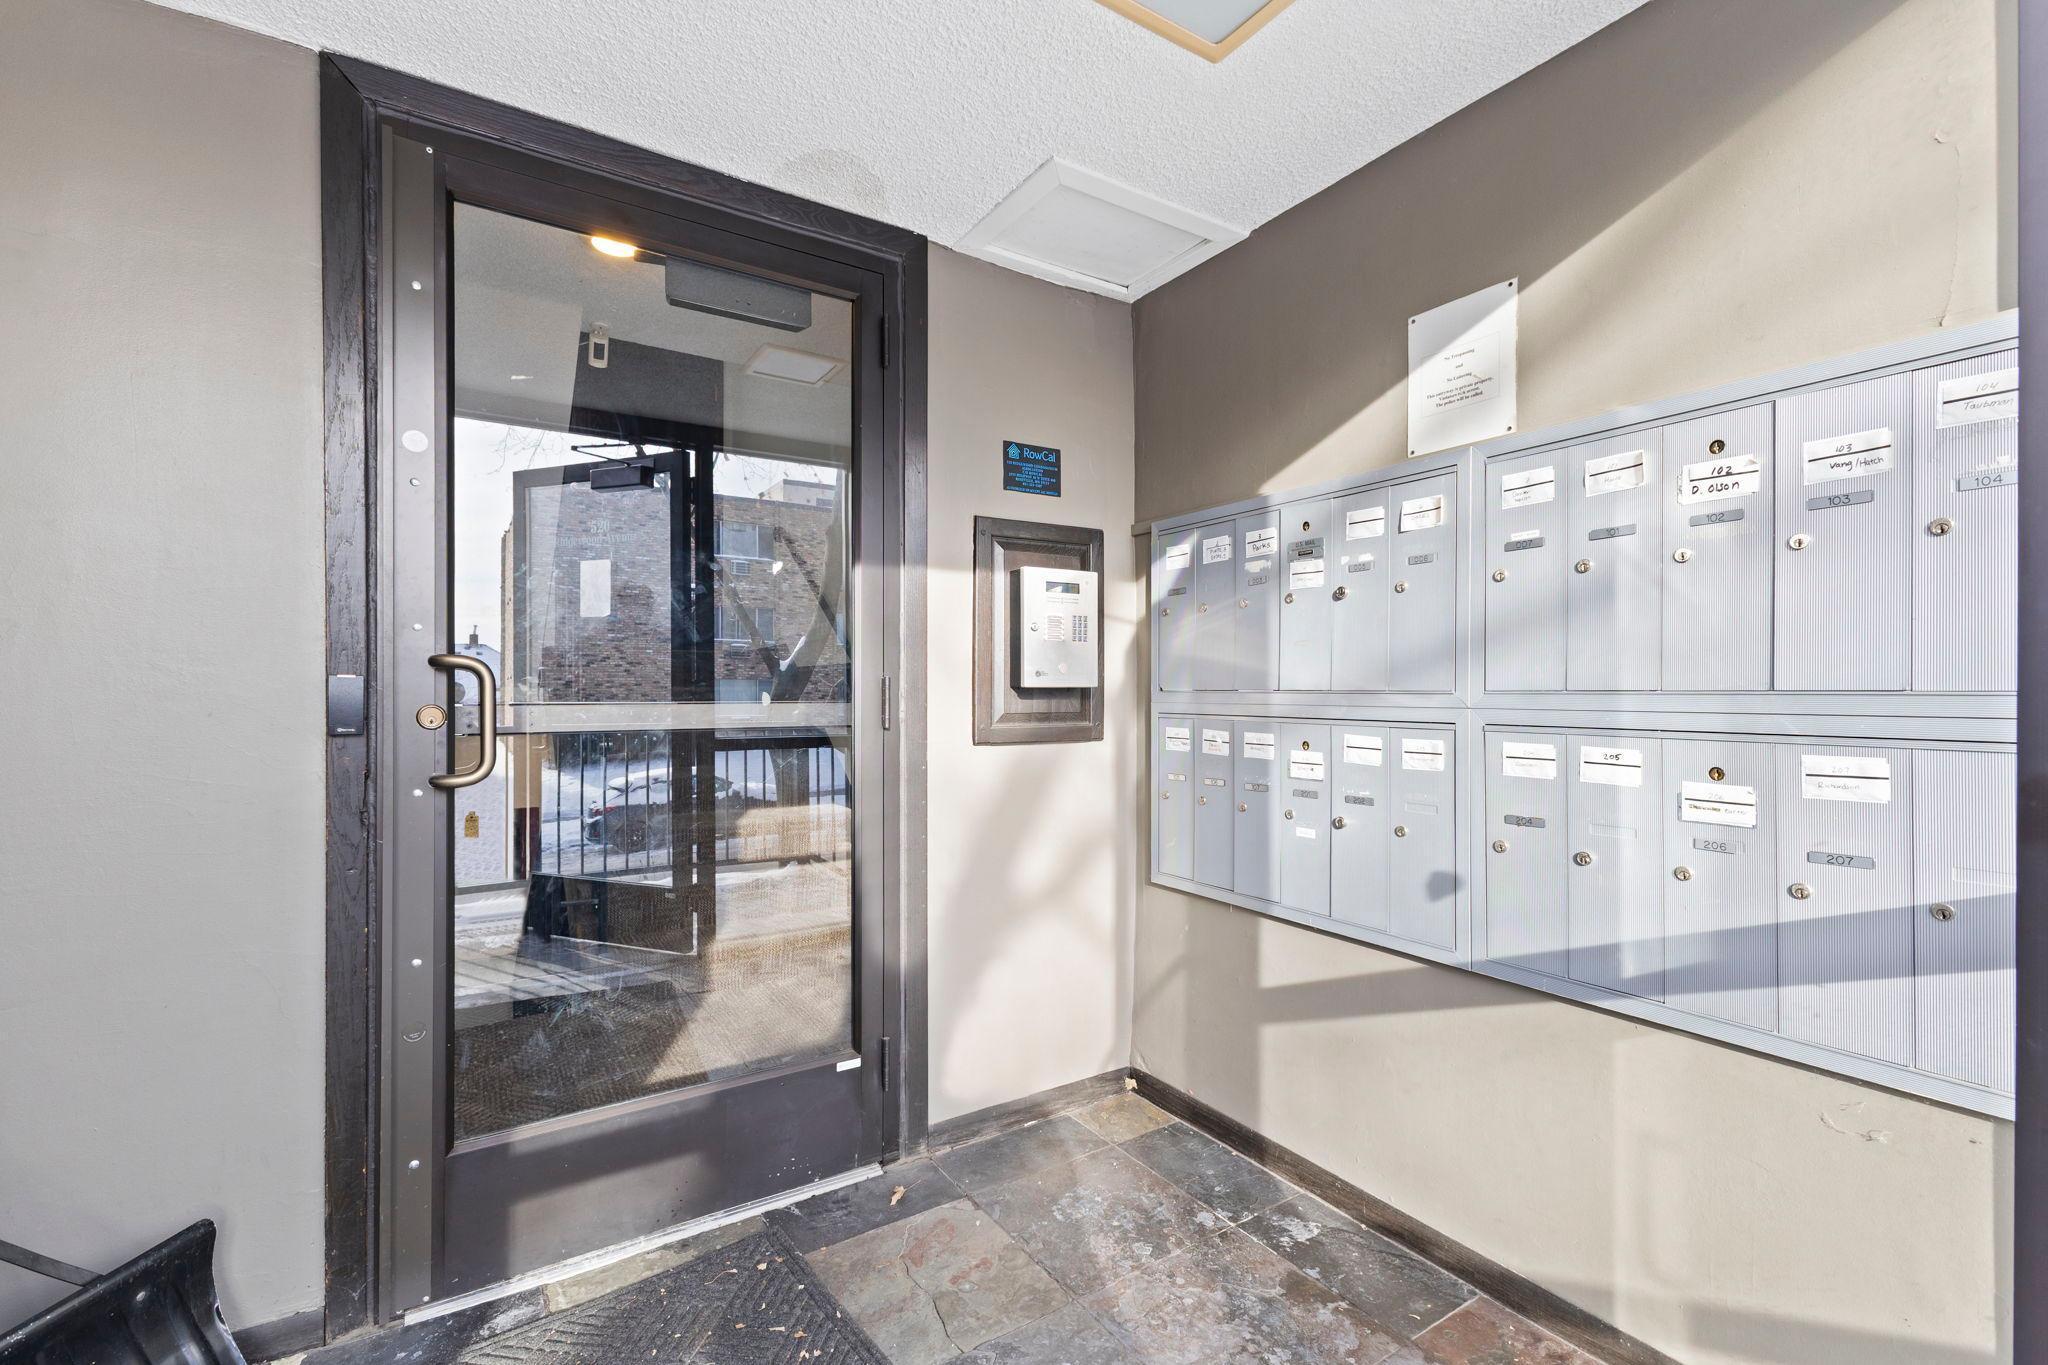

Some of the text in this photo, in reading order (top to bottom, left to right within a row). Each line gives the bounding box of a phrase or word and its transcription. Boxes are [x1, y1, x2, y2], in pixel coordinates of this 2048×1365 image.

[1836, 443, 1853, 453] 103
[1023, 447, 1056, 462] RowCal
[1711, 465, 1732, 475] 102
[1974, 474, 2004, 487] 104
[1692, 485, 1703, 495] D.
[1828, 494, 1851, 506] 103
[1706, 512, 1725, 523] 102
[590, 519, 610, 534] 520
[1606, 527, 1620, 537] 101
[1515, 540, 1533, 549] 007
[1603, 753, 1622, 761] 205
[1703, 840, 1727, 852] 206
[1826, 854, 1855, 866] 207
